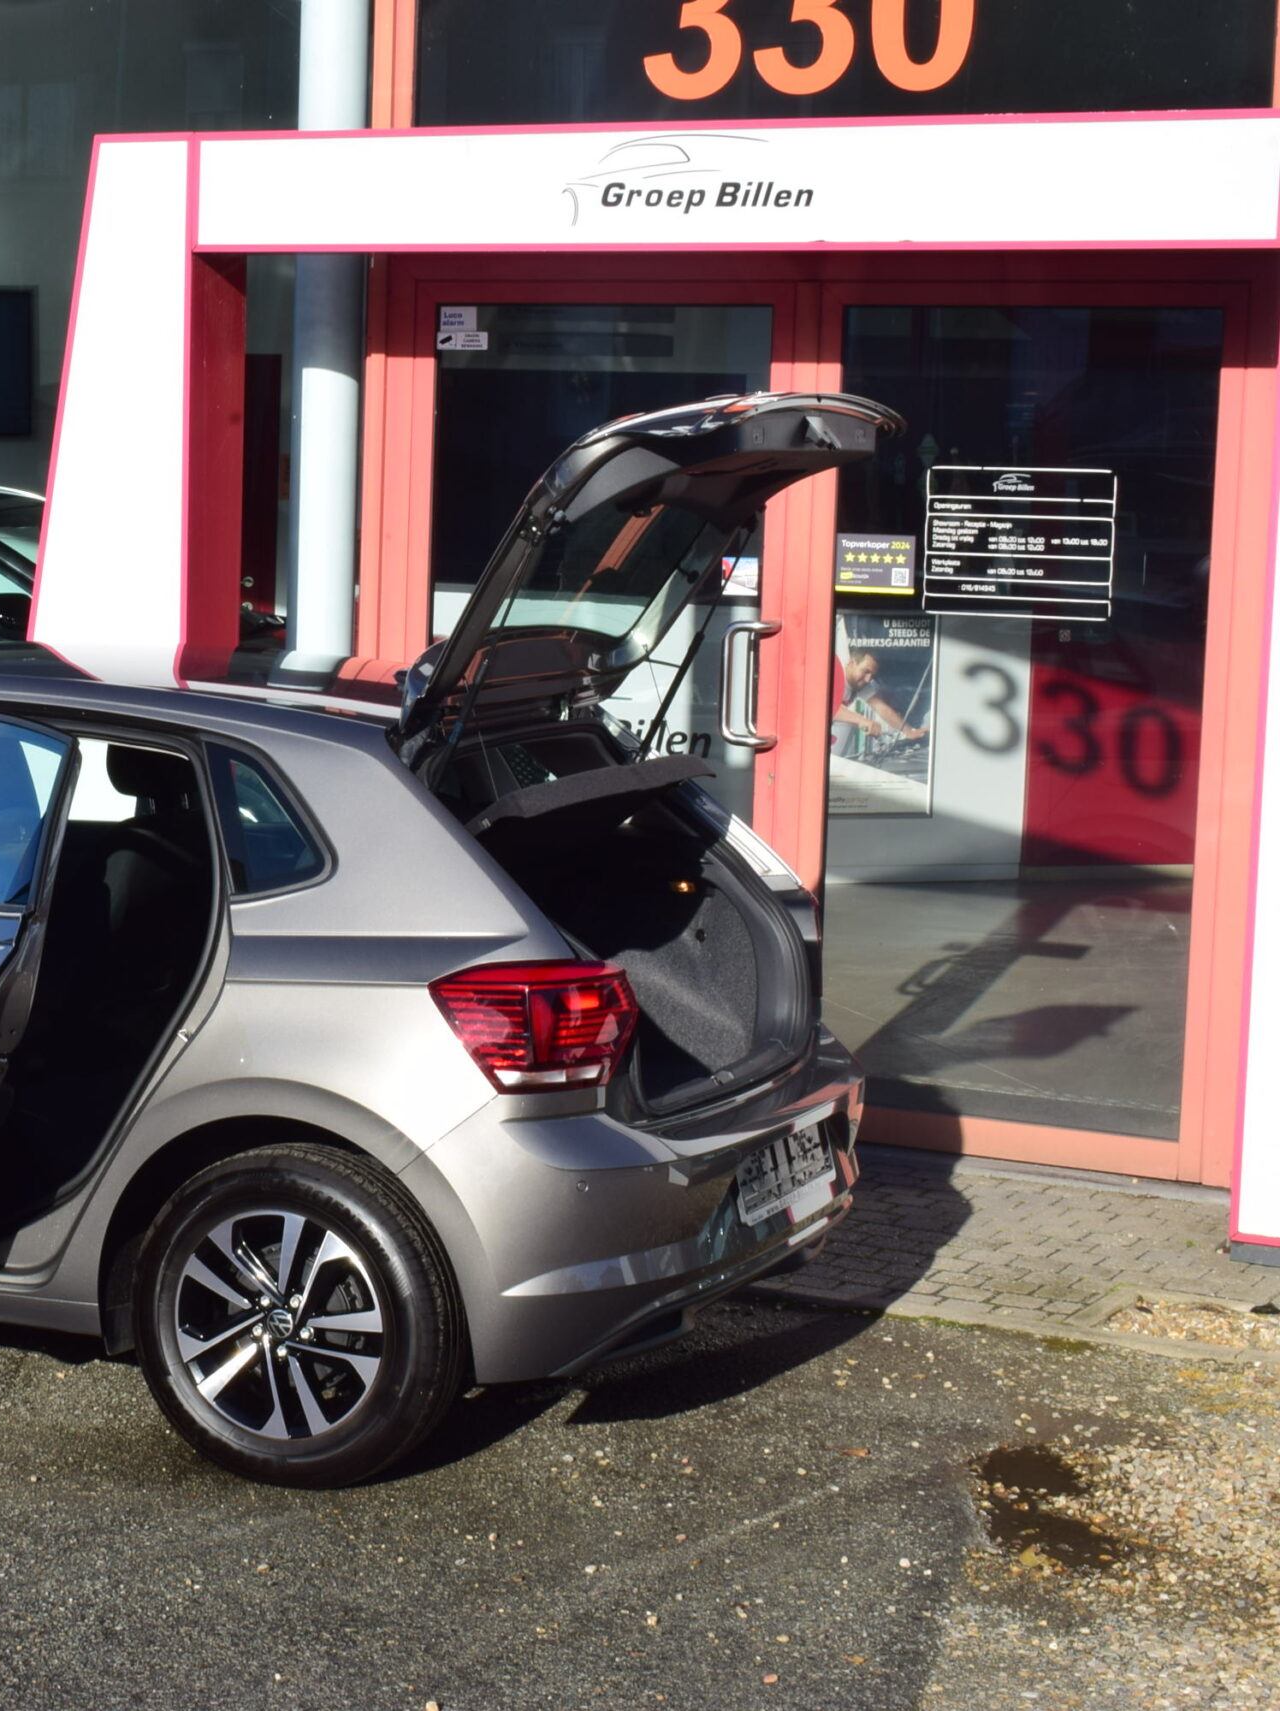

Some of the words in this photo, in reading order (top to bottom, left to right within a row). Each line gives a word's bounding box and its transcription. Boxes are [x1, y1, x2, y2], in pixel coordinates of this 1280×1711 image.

[643, 0, 975, 100] 330
[600, 182, 706, 214] Groep
[715, 181, 814, 208] Billen
[842, 540, 890, 549] Topverkoper
[891, 541, 911, 550] 2024
[883, 619, 890, 628] U
[889, 629, 918, 638] STEEDS
[920, 629, 931, 638] DE
